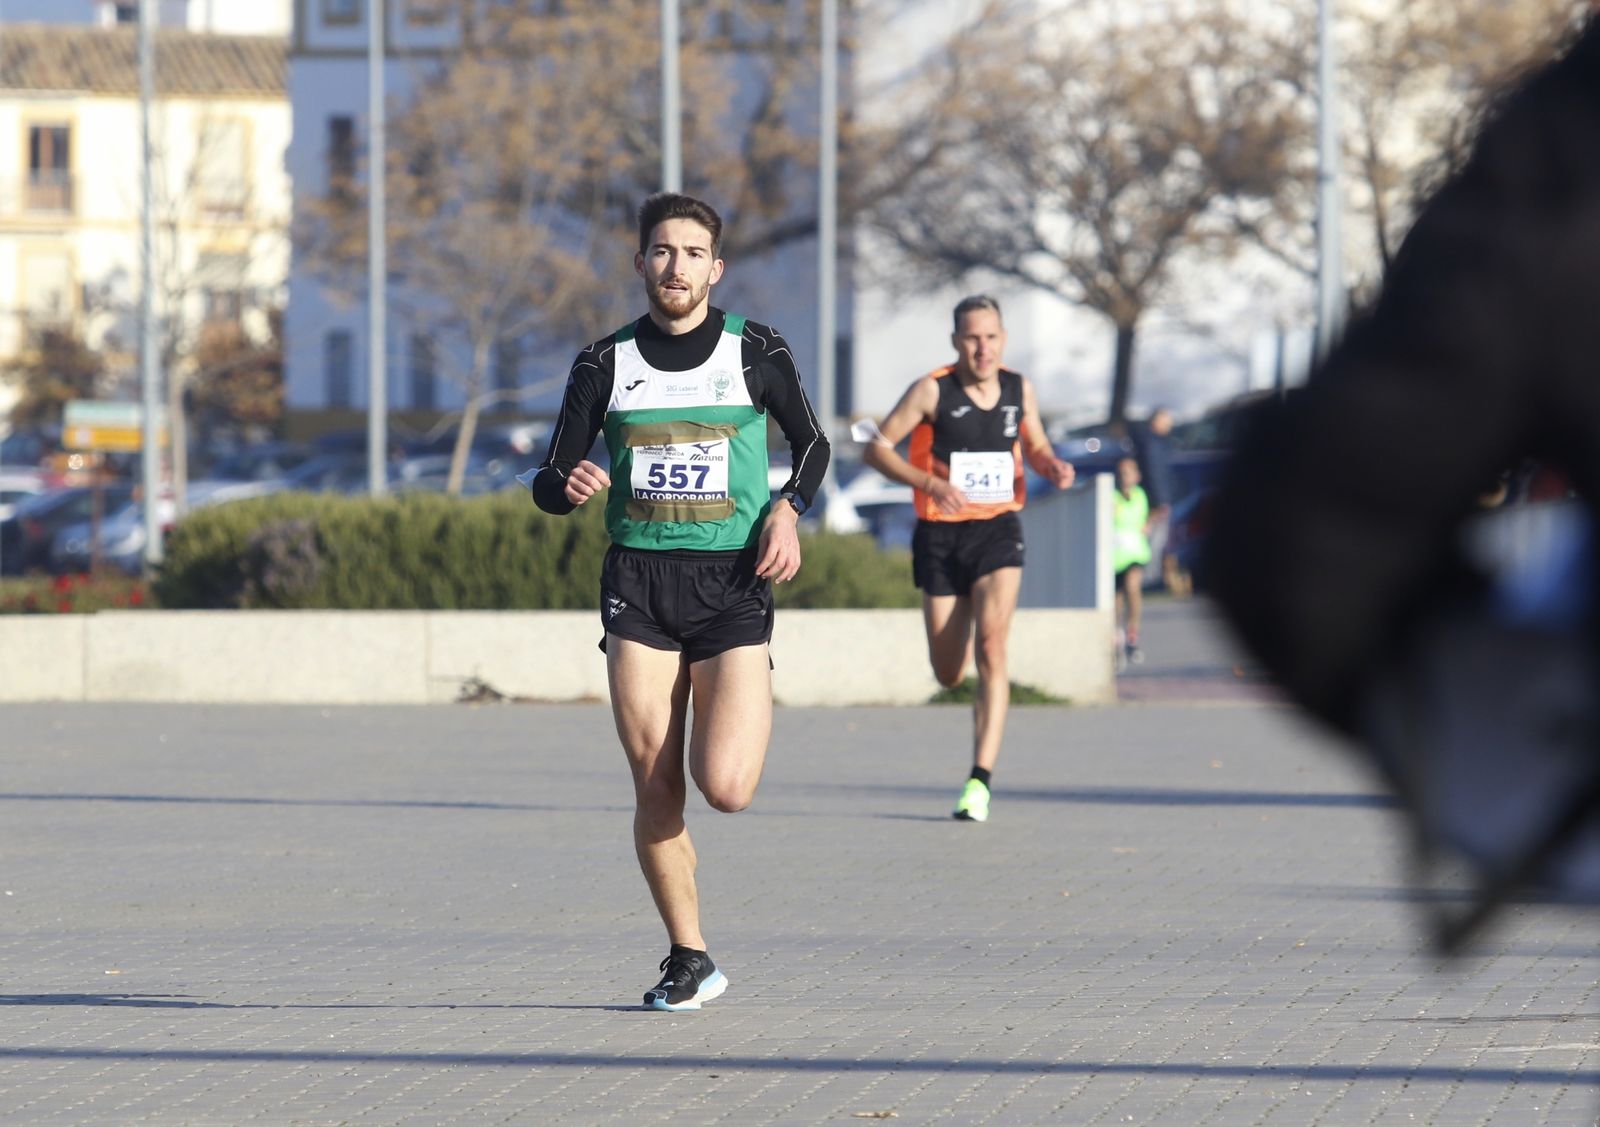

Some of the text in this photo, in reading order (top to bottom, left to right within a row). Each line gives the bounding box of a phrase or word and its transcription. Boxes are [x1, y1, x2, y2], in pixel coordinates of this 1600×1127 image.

[647, 463, 710, 489] 557
[964, 472, 1001, 488] 541
[636, 490, 649, 500] LA
